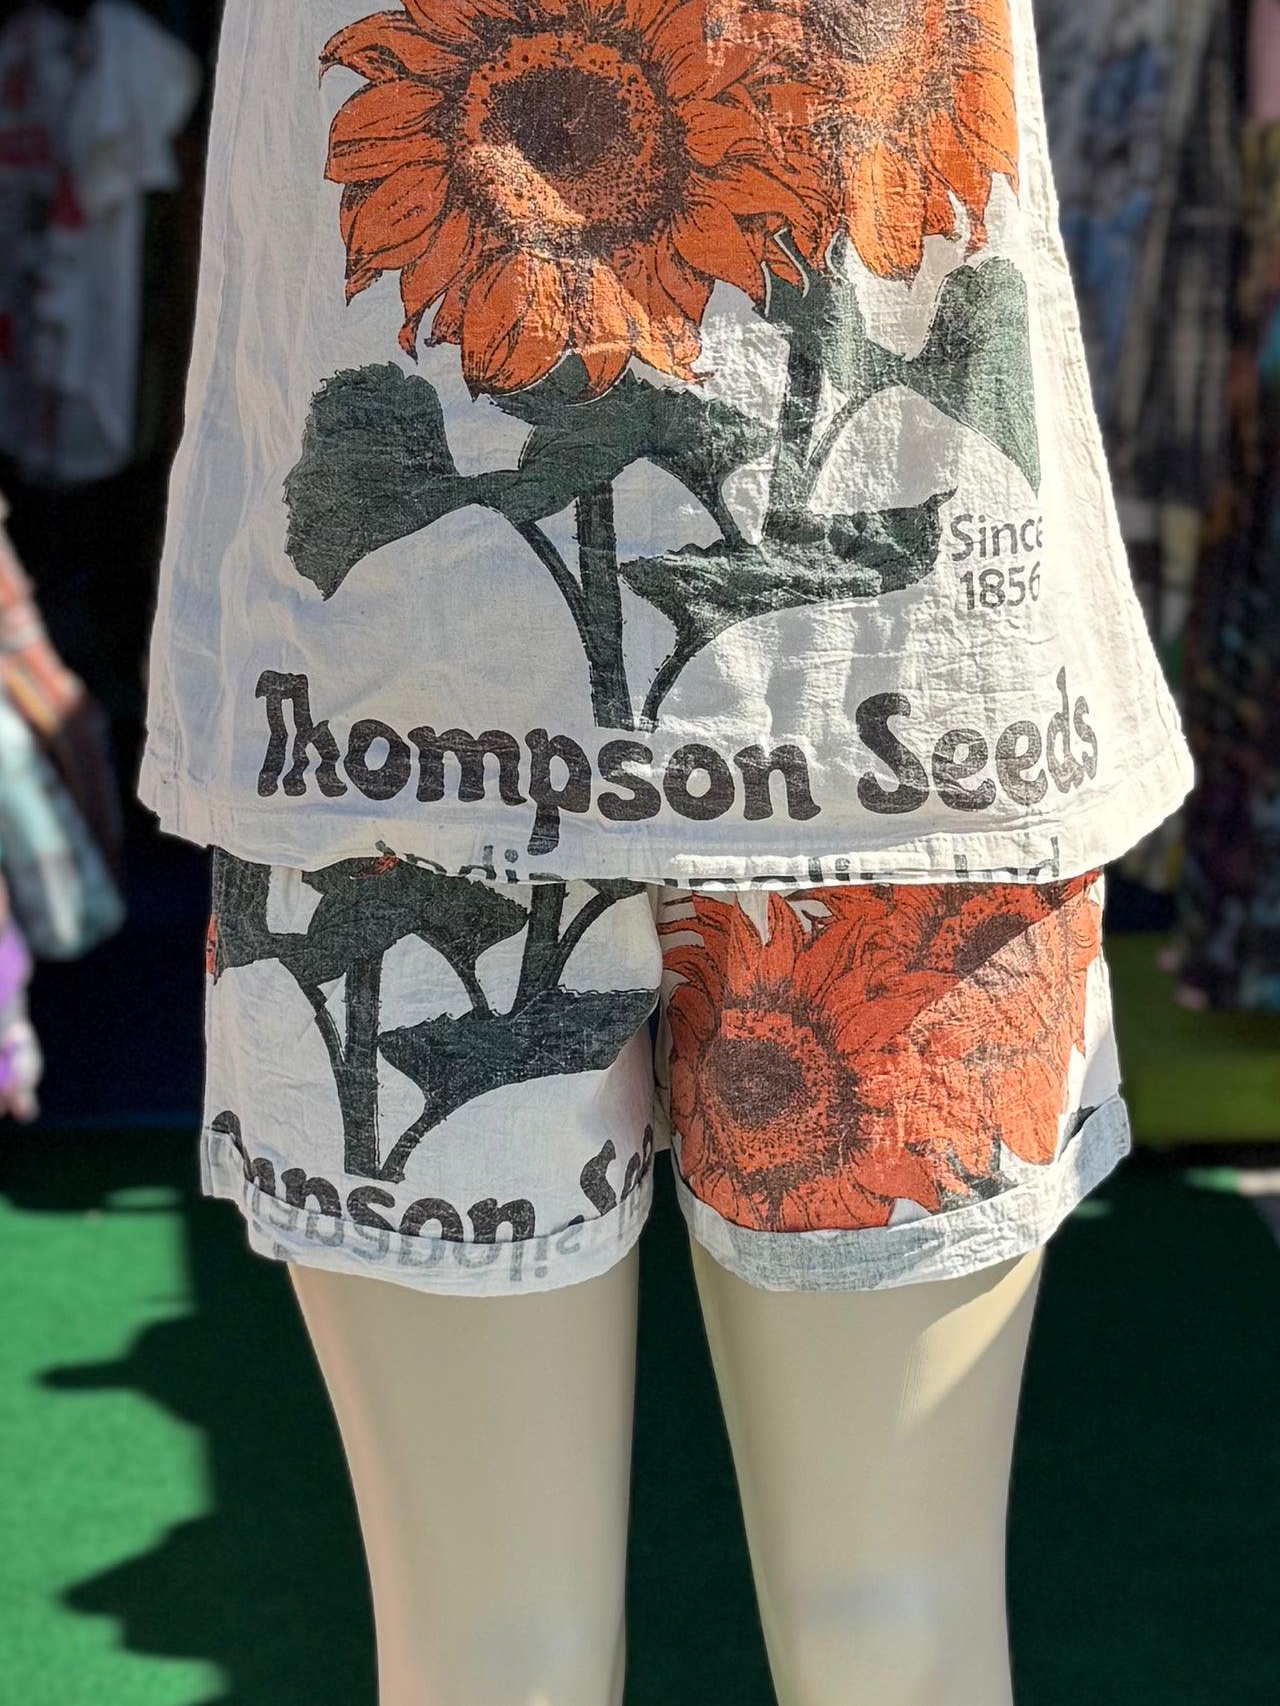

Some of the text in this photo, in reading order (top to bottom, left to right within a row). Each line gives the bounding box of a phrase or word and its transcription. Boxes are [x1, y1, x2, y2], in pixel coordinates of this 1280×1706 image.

[949, 513, 1043, 562] Since
[959, 560, 1041, 610] 1856
[255, 665, 1100, 855] Thompson Seeds
